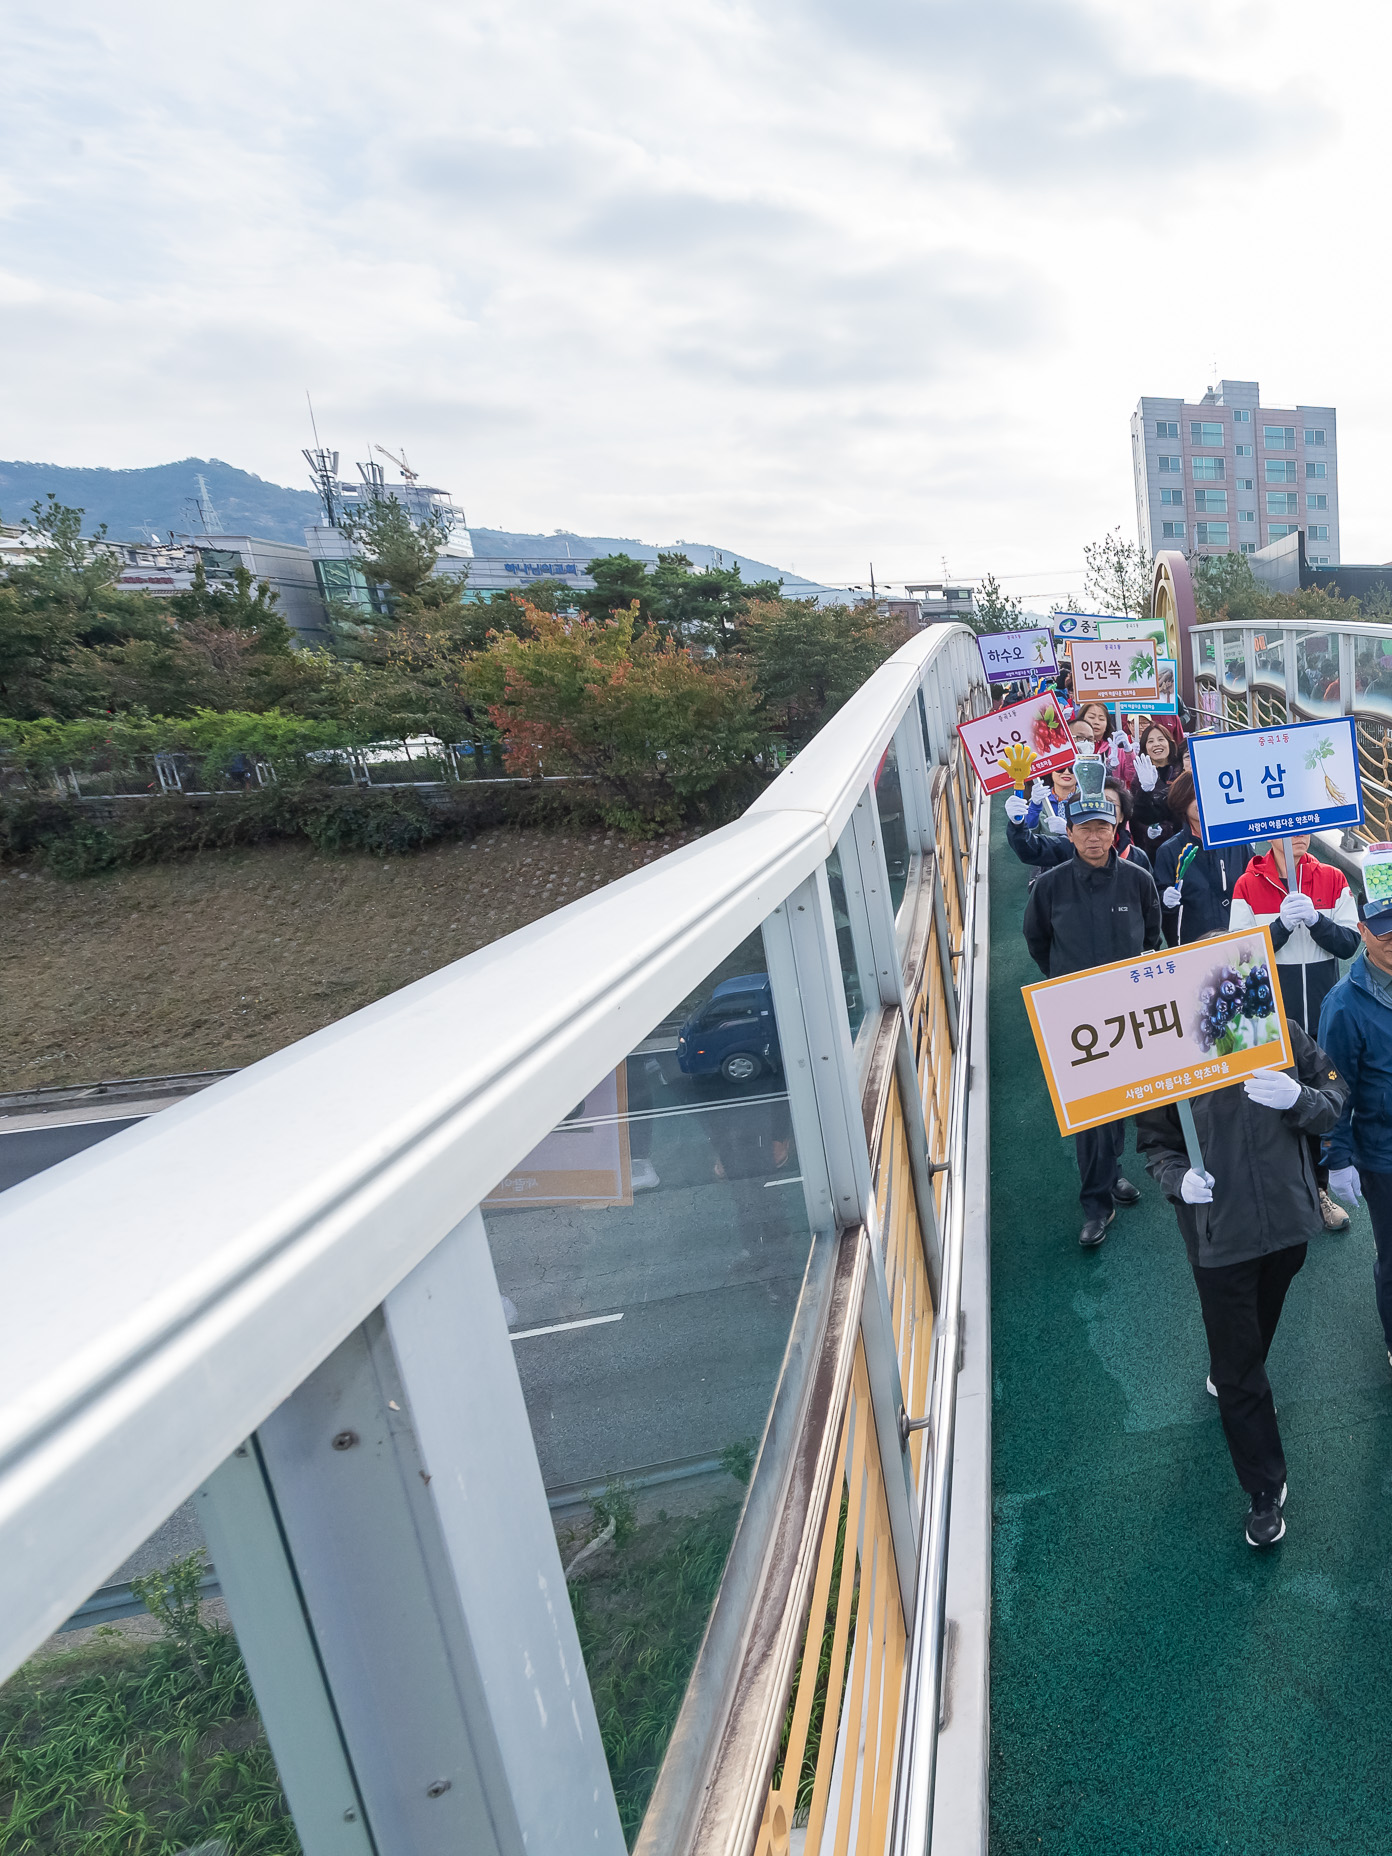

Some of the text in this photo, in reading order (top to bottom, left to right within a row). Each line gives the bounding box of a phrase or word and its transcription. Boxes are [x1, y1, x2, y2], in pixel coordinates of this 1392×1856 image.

[987, 646, 1025, 664] 하수오
[1081, 660, 1122, 681] 인진쑥
[1258, 733, 1289, 747] 중곡1동
[1248, 812, 1321, 833] 사람이 아름다운 약초마을
[1129, 960, 1177, 984] 중곡1동
[1070, 1000, 1184, 1067] 오가피
[1125, 1060, 1231, 1100] 사람이 아름다운 약초마을
